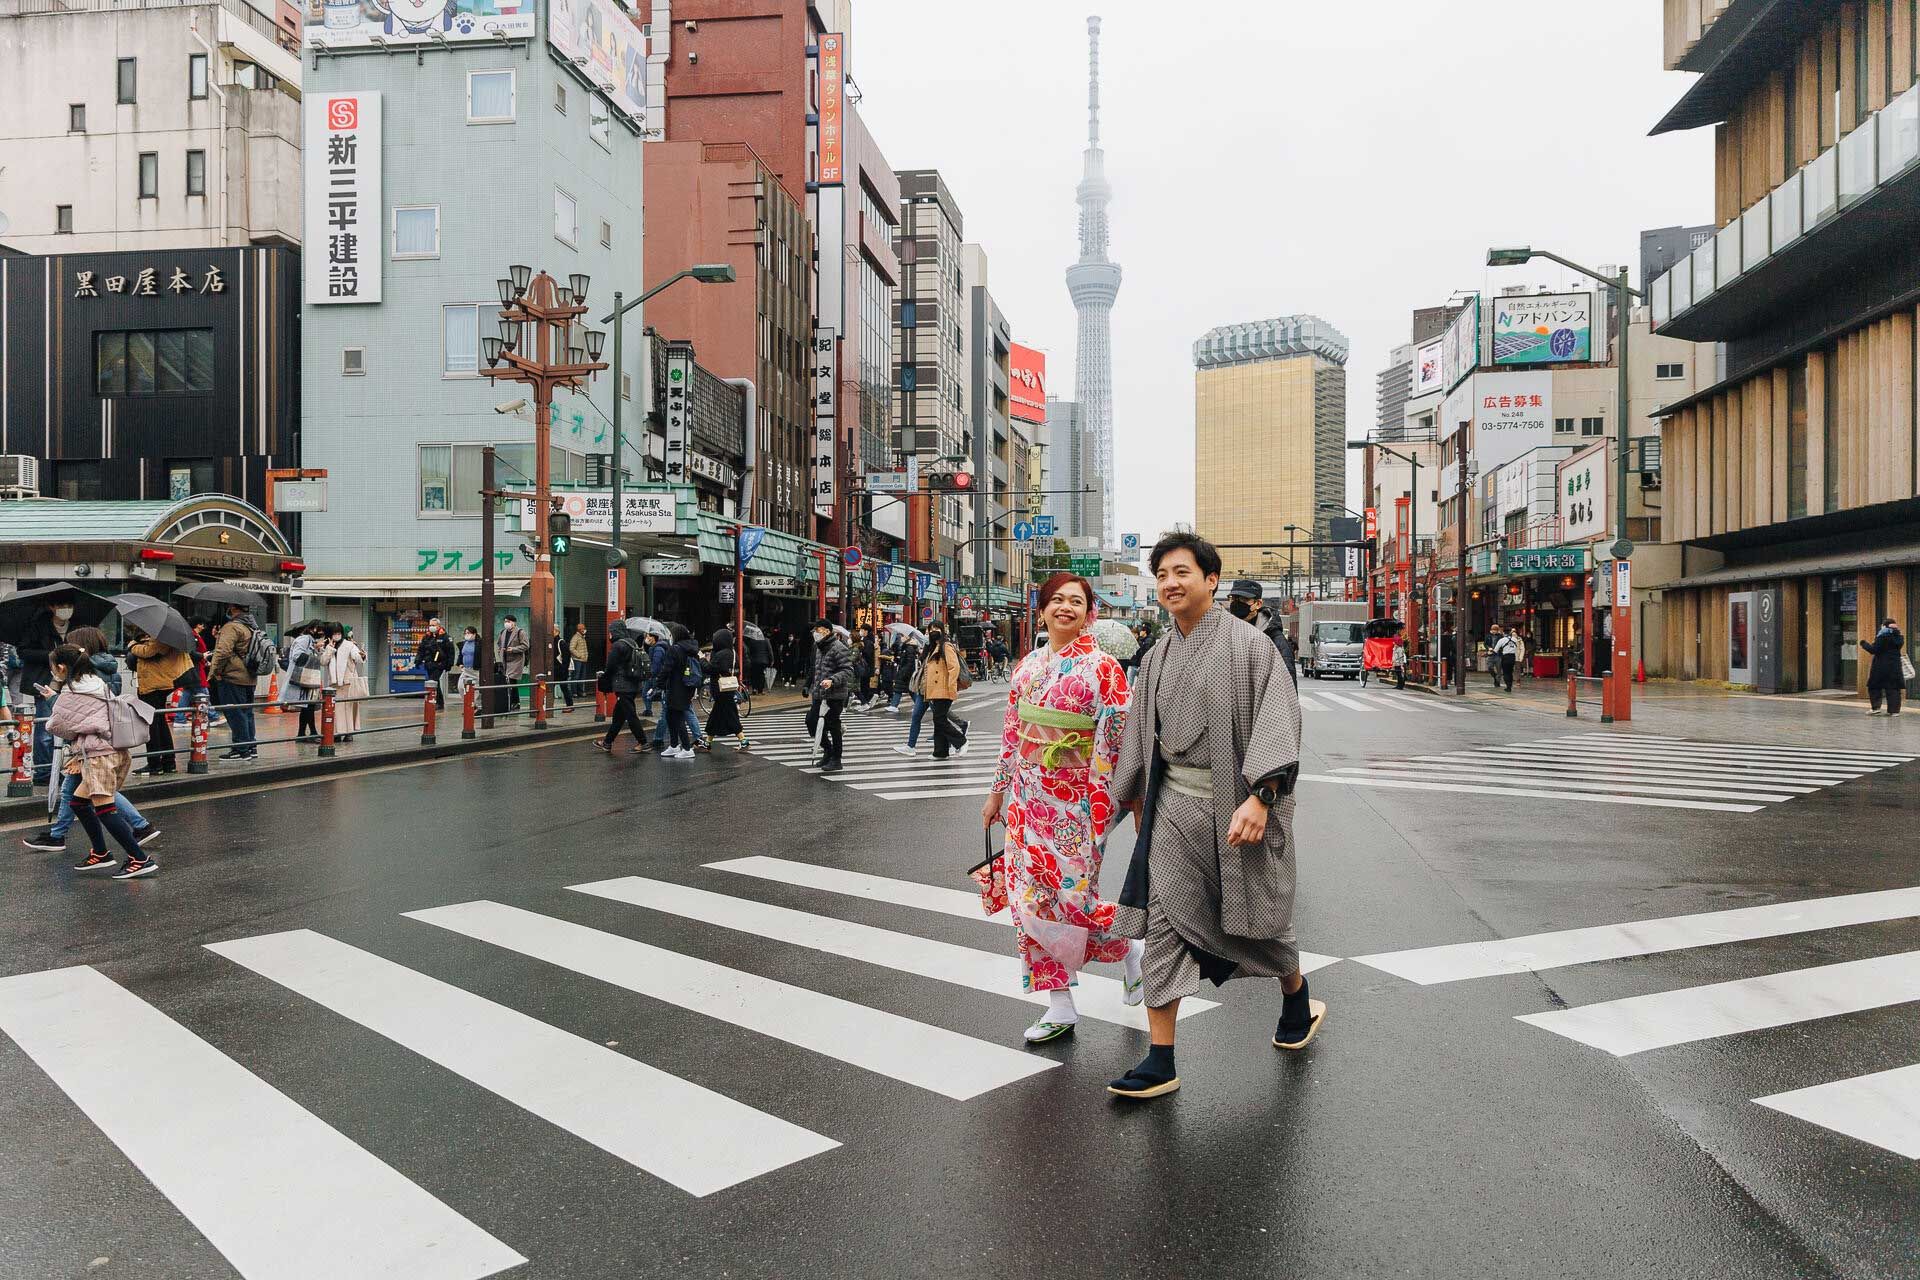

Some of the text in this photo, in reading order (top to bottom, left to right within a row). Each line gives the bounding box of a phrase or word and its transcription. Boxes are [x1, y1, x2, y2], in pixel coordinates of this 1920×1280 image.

[823, 168, 839, 179] 5F
[328, 134, 358, 297] 新三平建設
[74, 264, 225, 298] 黒田屋本店
[1508, 300, 1577, 311] 自然エネルギーの
[1516, 310, 1587, 325] アドバンス
[1483, 394, 1543, 409] 広告募集
[667, 387, 684, 476] 天ぷら三定
[626, 499, 660, 510] 浅草駅
[626, 509, 657, 517] Asakusa
[1510, 554, 1575, 568] 雷門東部
